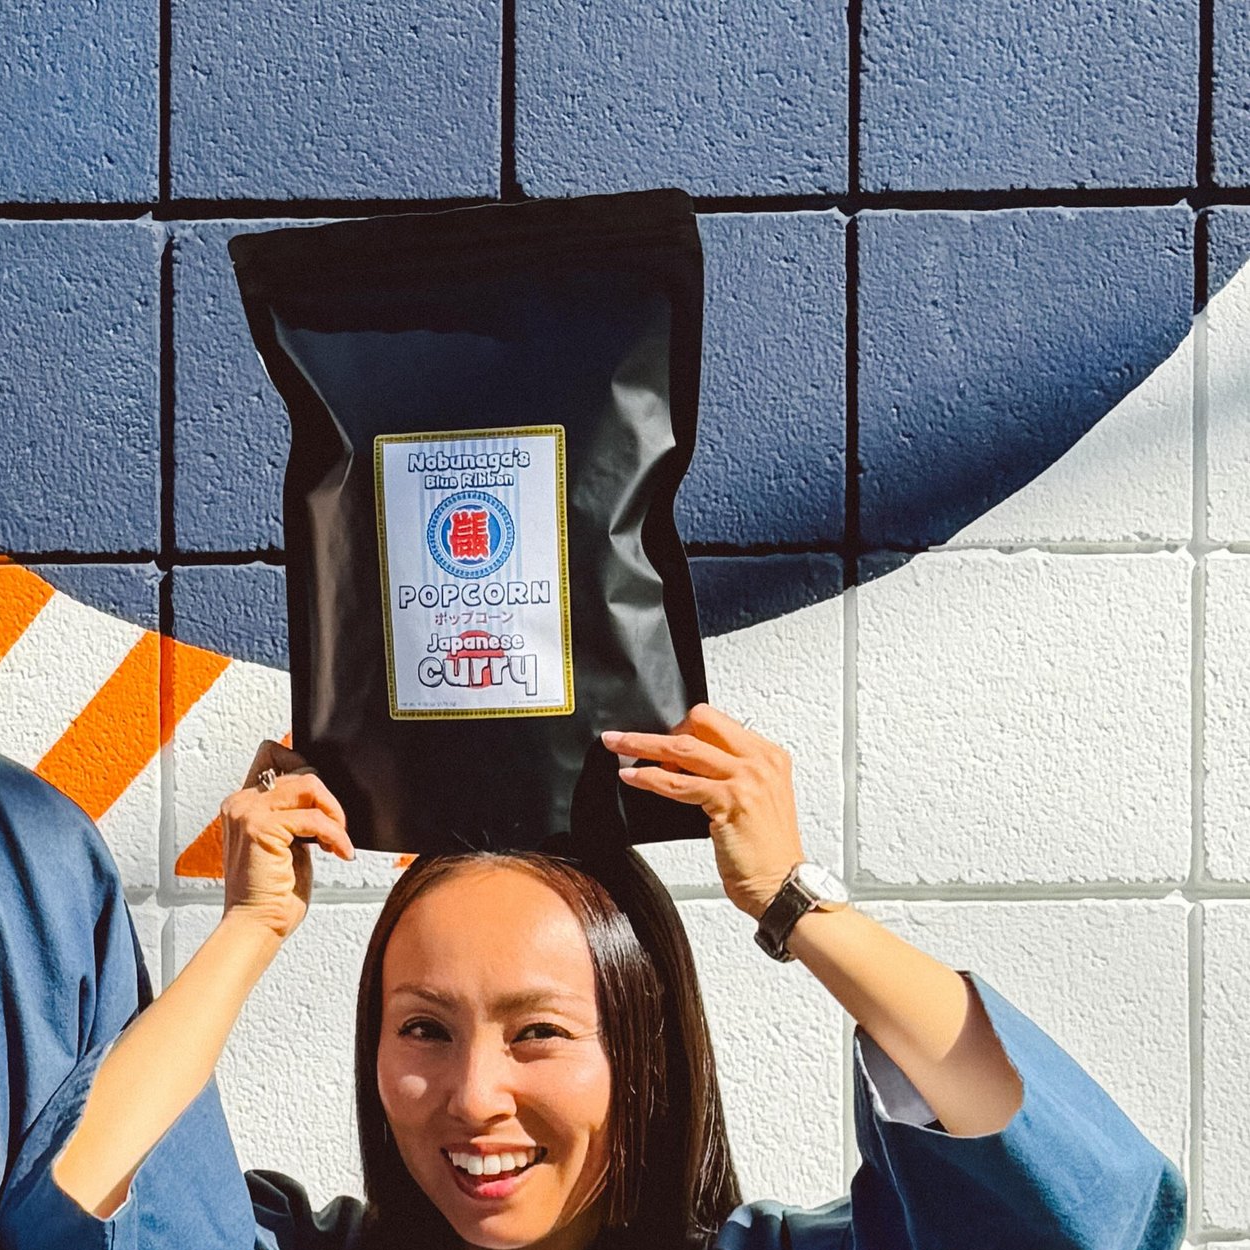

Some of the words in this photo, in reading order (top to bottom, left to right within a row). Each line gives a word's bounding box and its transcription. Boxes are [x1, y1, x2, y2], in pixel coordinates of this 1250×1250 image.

[408, 448, 530, 474] Nobunaga's
[424, 474, 459, 489] Blue
[461, 472, 514, 489] Ribbon
[399, 581, 551, 609] POPCORN
[435, 611, 514, 626] ポップコーン
[427, 633, 524, 656] Japanese
[418, 654, 537, 696] curry
